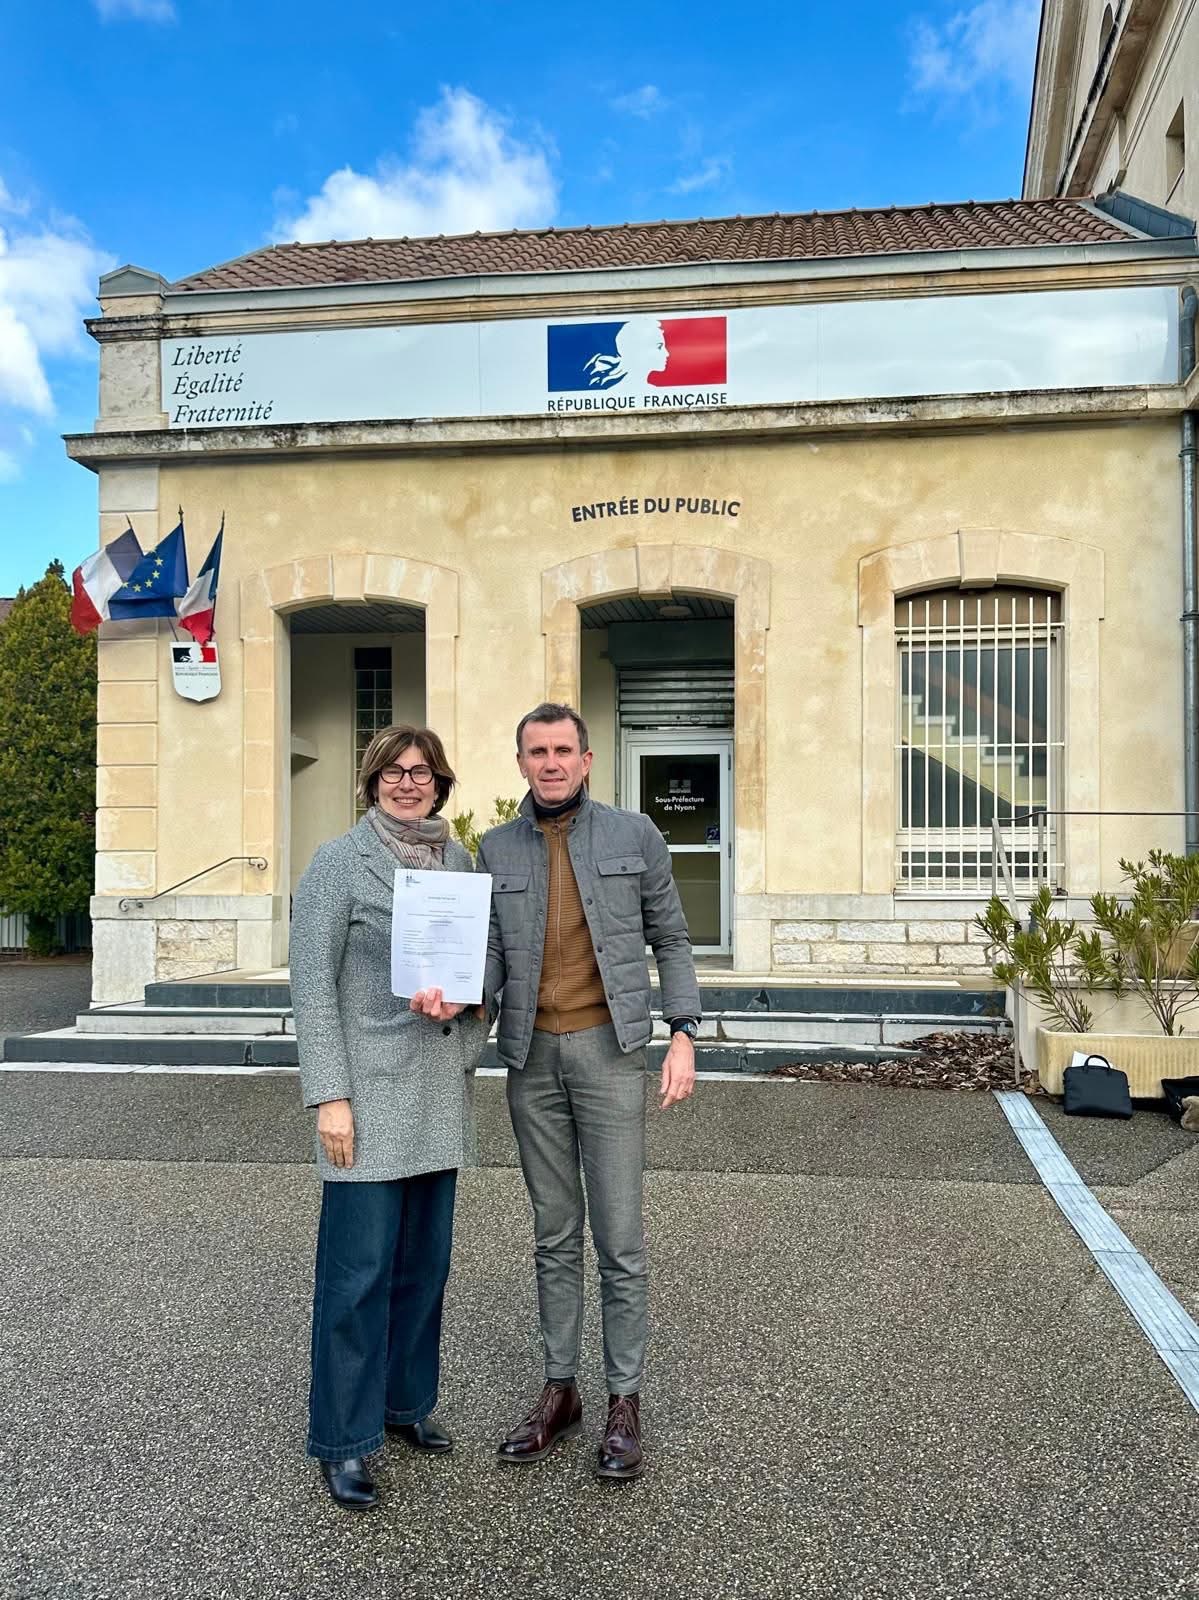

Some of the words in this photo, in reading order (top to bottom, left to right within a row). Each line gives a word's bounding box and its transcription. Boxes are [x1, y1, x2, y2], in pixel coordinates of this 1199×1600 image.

[171, 344, 242, 366] Liberté
[171, 371, 244, 400] Égalité
[172, 400, 274, 423] Fraternité
[547, 397, 636, 412] RÉPUBLIQUE
[644, 392, 727, 408] FRANÇAISE
[572, 496, 639, 523] ENTRÉE
[644, 498, 670, 514] DU
[675, 498, 741, 517] PUBLIC
[674, 804, 696, 812] Nyons
